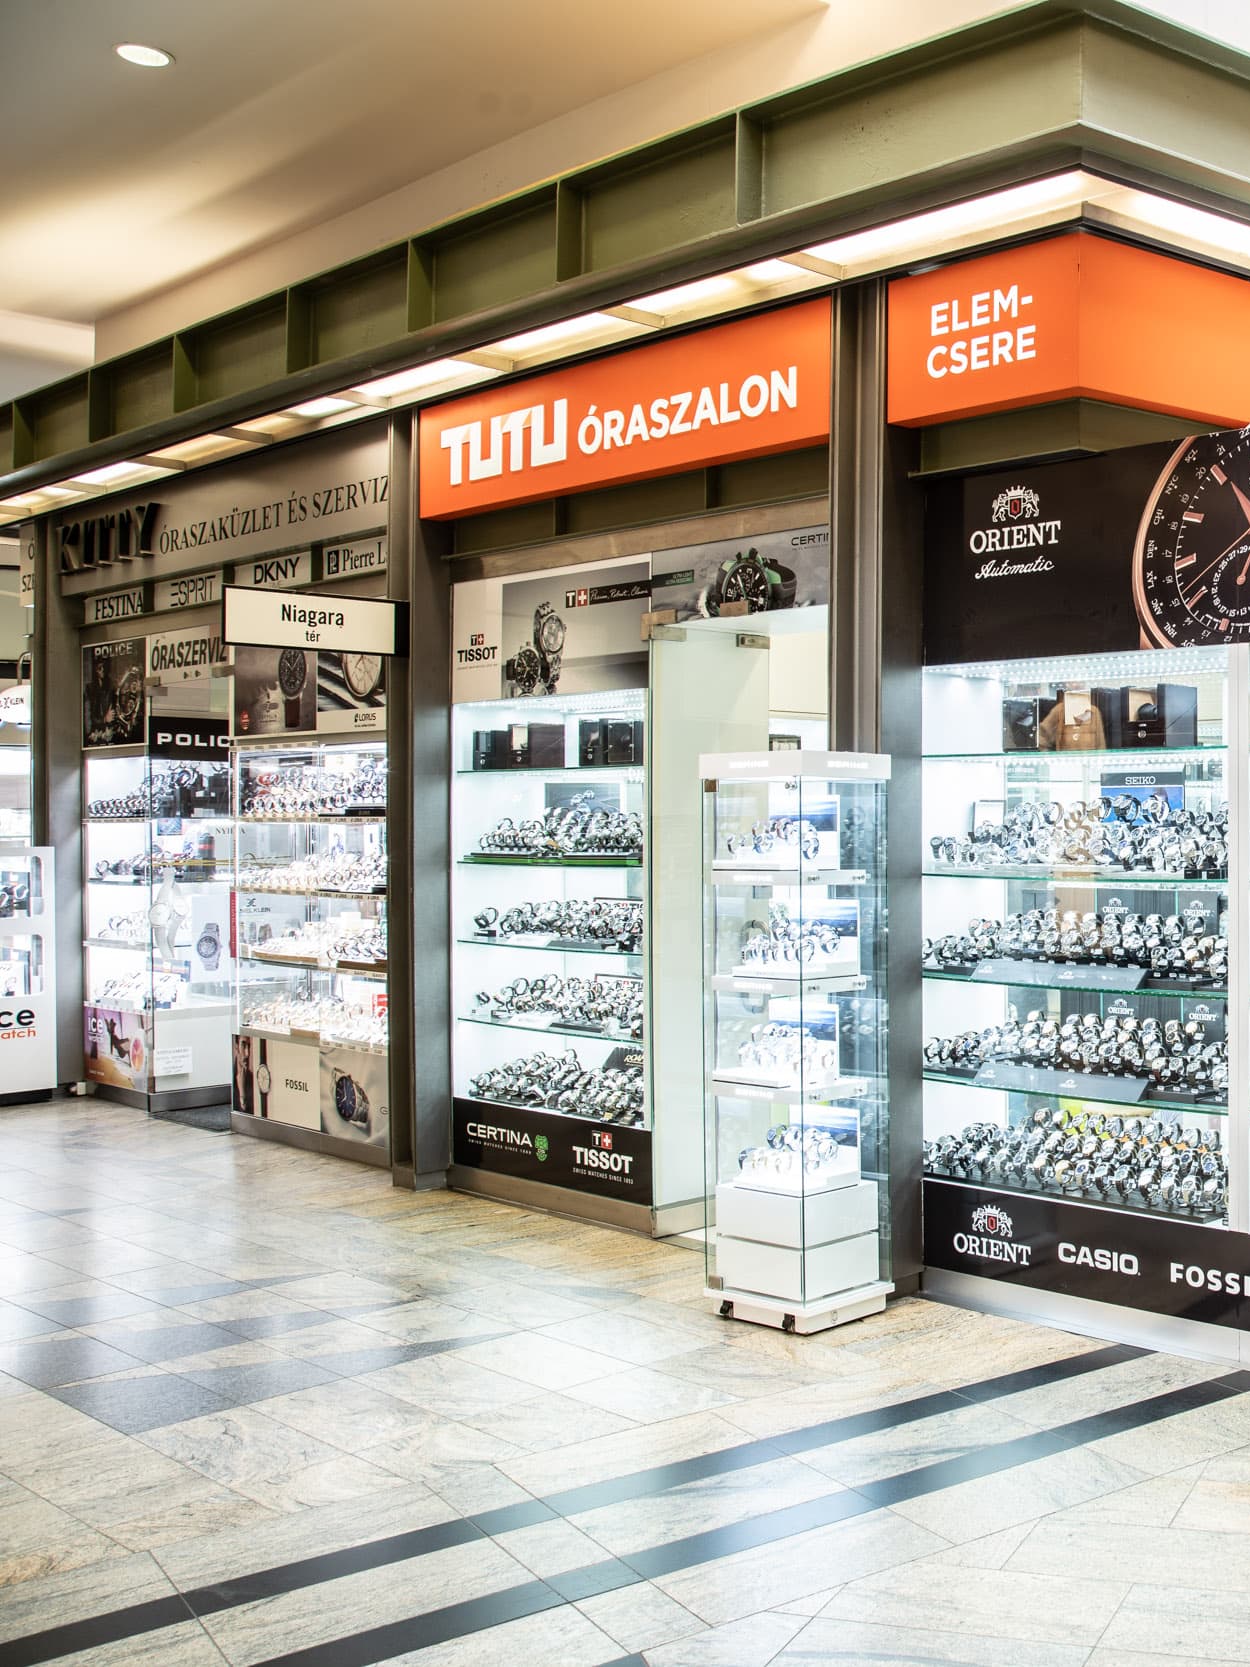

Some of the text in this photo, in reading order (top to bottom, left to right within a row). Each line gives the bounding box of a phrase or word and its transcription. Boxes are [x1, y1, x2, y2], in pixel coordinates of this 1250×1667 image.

[931, 284, 1034, 337] ELEM-
[926, 324, 1037, 379] CSERE
[440, 365, 798, 485] TUTU ÓRASZALON
[159, 475, 389, 555] ÓRASZAKÜZLET ÉS SZERVIZ
[969, 520, 1061, 554] ORIENT
[341, 541, 388, 572] Pierre L
[974, 555, 1056, 580] Automatic
[253, 556, 301, 585] DKNY
[170, 574, 217, 608] ESPRIT
[94, 591, 144, 621] FESTINA
[281, 603, 345, 628] Niagara
[305, 629, 321, 643] tér
[94, 641, 134, 660] POLICE
[151, 636, 228, 672] ÓRASZERVIZ
[457, 646, 498, 663] TISSOT
[358, 712, 377, 722] LORUS
[1124, 775, 1157, 785] SEIKO
[1102, 906, 1129, 915] ORIENT
[1183, 909, 1211, 919] ORIENT
[1107, 1005, 1135, 1016] ORIENT
[1188, 1013, 1217, 1023] ORIENT
[285, 1078, 309, 1093] FOSSIL
[466, 1122, 533, 1148] CERTINA
[572, 1145, 634, 1175] TISSOT
[952, 1232, 1032, 1266] ORIENT
